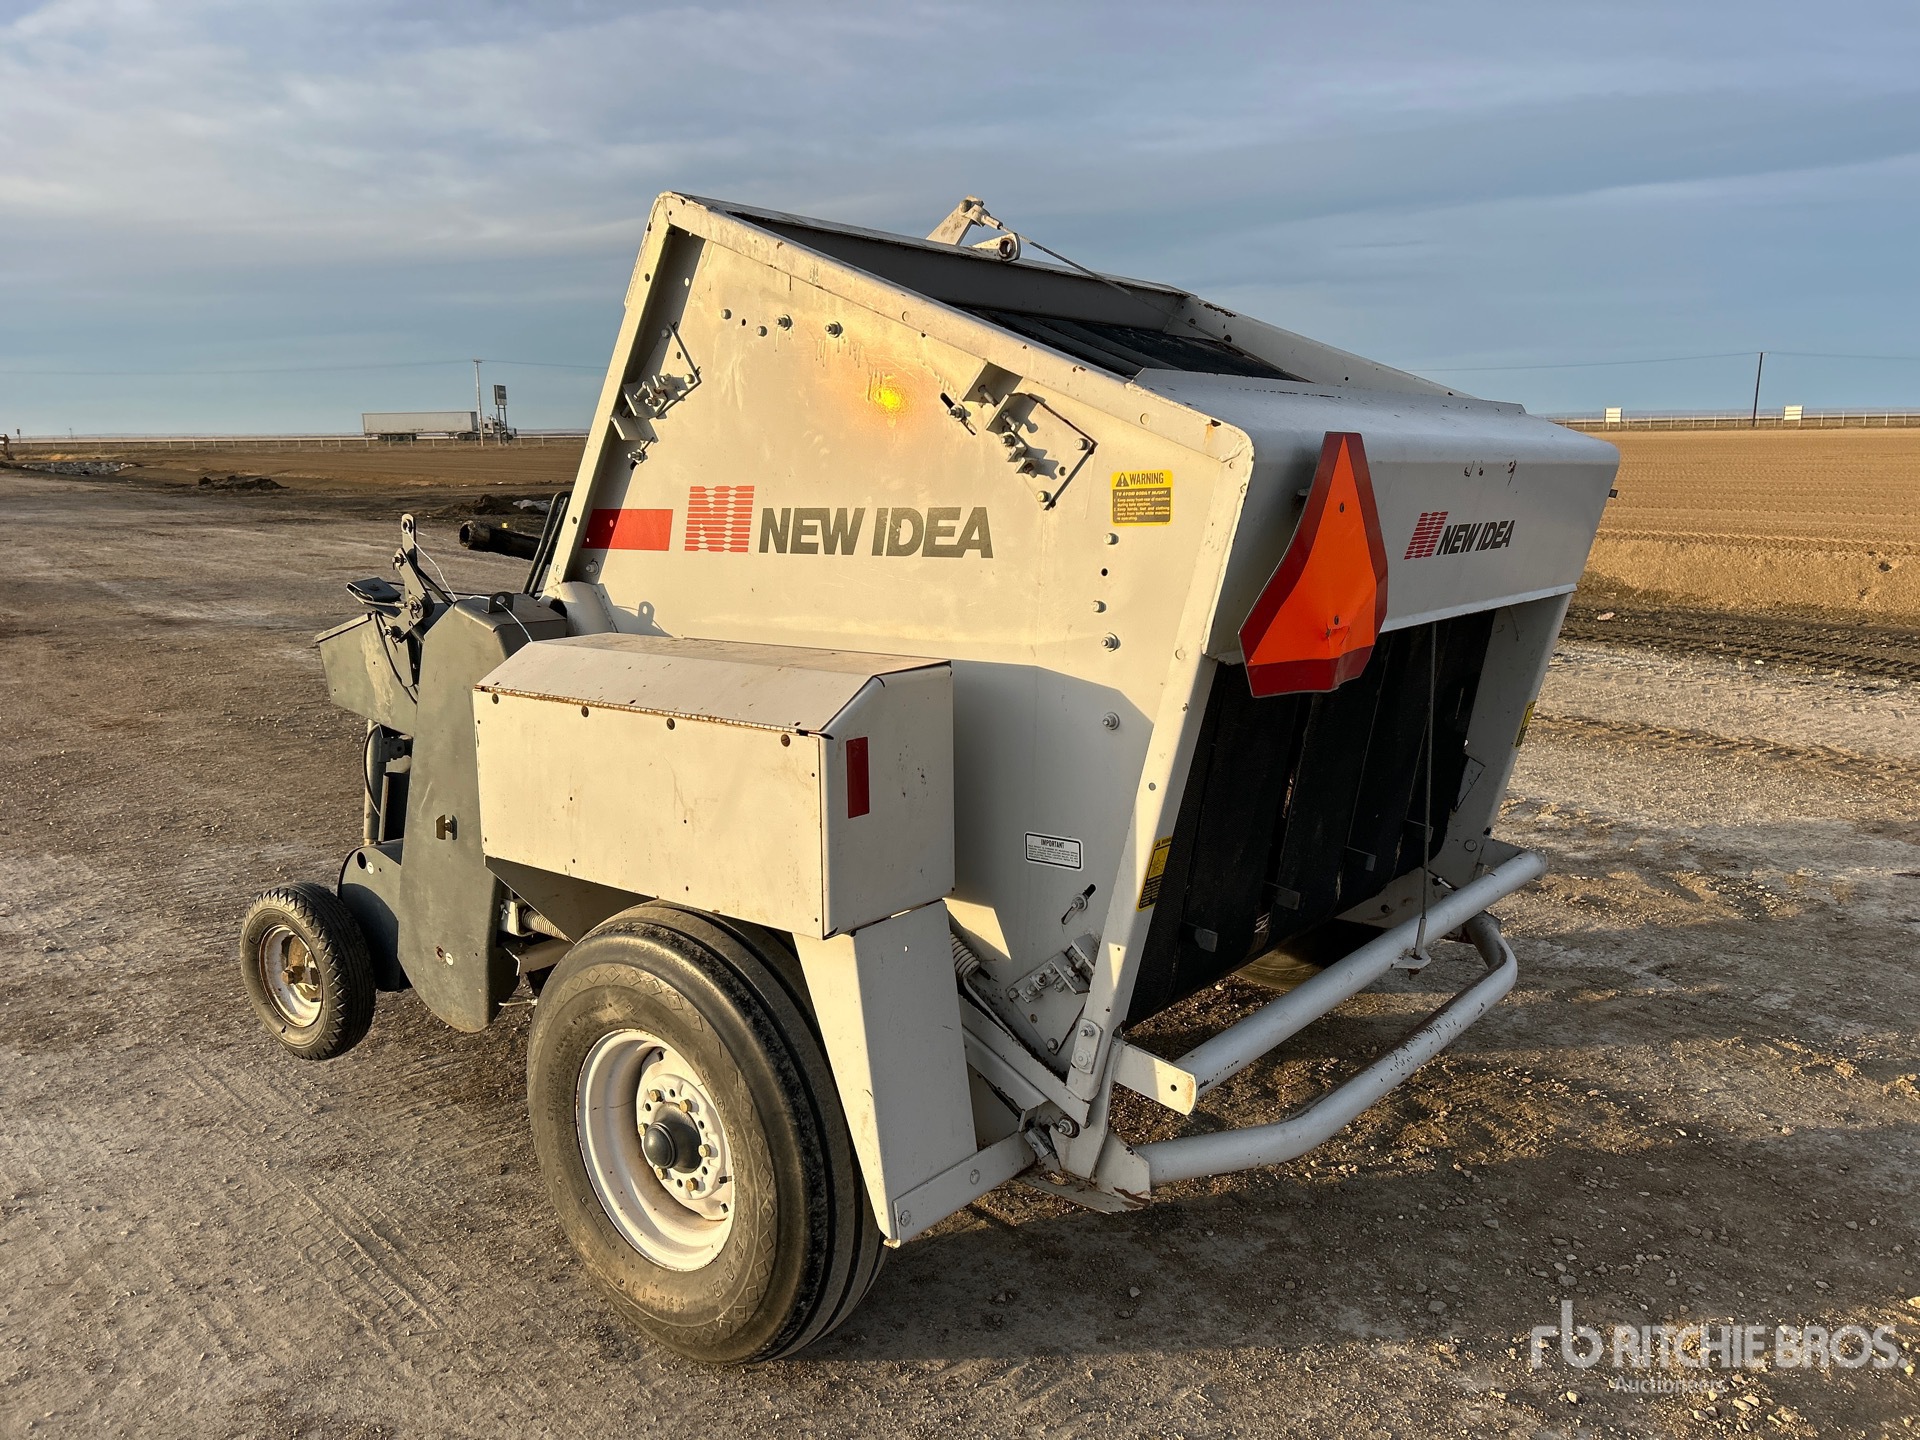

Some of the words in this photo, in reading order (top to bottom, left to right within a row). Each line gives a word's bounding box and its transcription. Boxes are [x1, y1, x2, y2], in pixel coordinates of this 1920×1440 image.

[1130, 472, 1163, 484] WARNING
[758, 507, 866, 555] NEW
[871, 506, 994, 559] IDEA
[1436, 522, 1483, 555] NEW
[1475, 520, 1515, 551] IDEA
[1041, 839, 1065, 849] IMPORTANT
